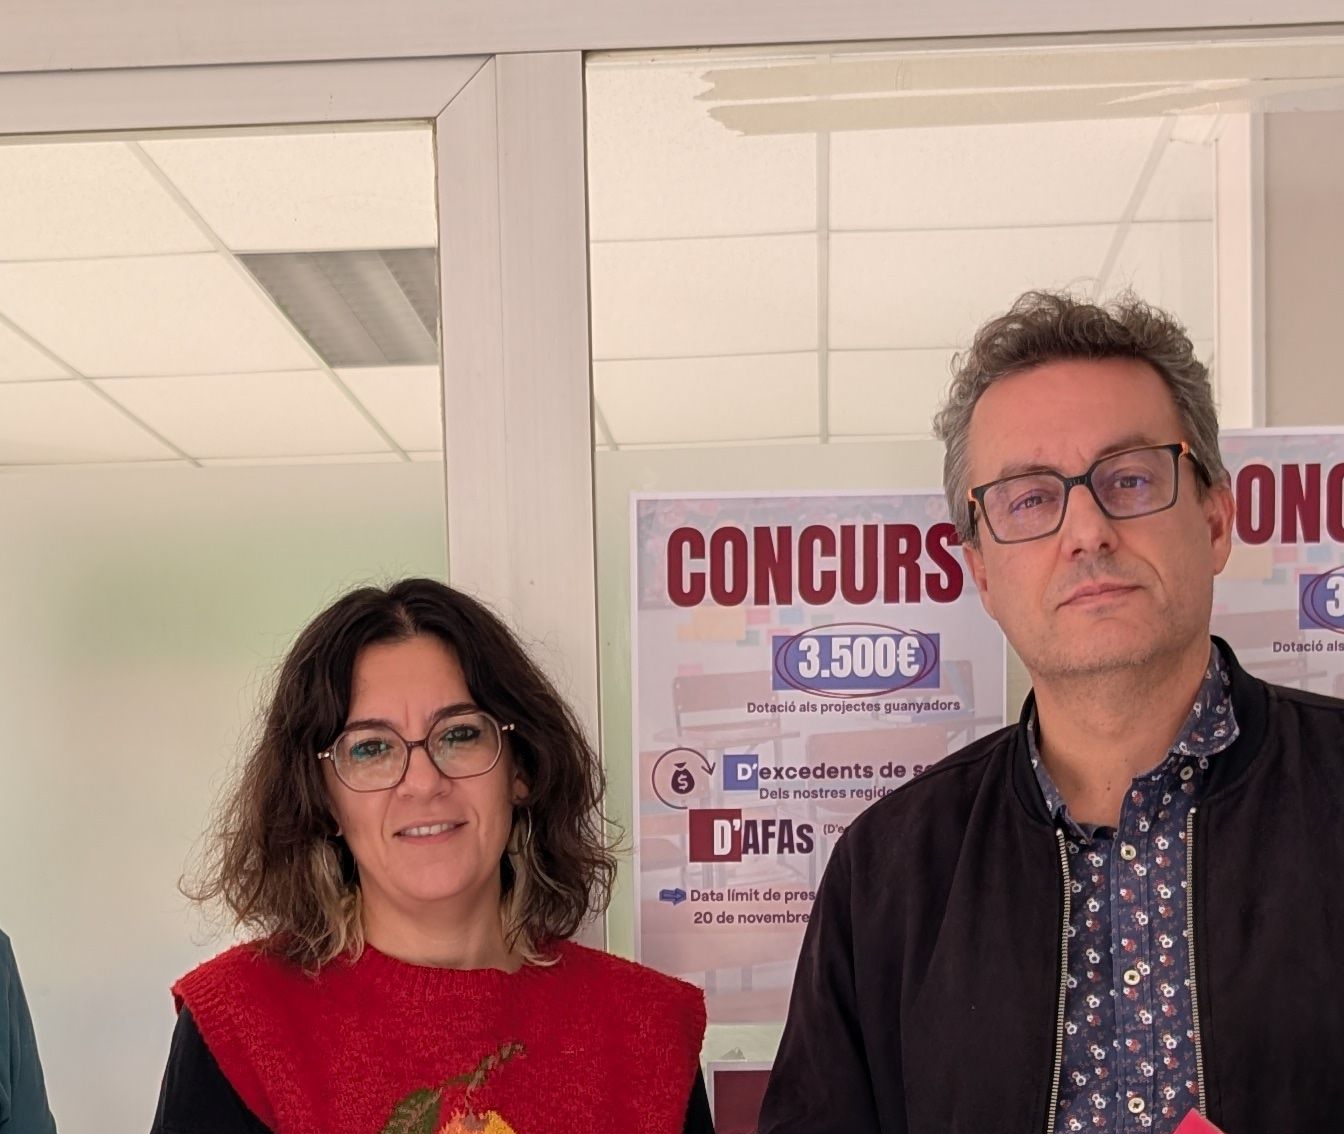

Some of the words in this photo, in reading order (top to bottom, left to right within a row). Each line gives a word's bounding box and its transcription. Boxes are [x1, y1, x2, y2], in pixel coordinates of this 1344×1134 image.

[667, 523, 963, 608] CONCURS
[1272, 640, 1324, 654] Dotació
[1326, 640, 1344, 653] als
[798, 637, 920, 679] 3.500€
[746, 700, 796, 714] Dotació
[799, 701, 817, 713] als
[820, 701, 881, 716] projectes
[884, 700, 961, 716] guanyadors
[736, 762, 873, 782] D'excedents
[880, 762, 907, 779] de
[760, 786, 790, 801] Dels
[792, 787, 847, 800] nostres
[690, 888, 724, 903] Data
[726, 888, 761, 902] límit
[763, 888, 781, 902] de
[784, 890, 816, 904] pres
[694, 912, 713, 925] 20
[716, 911, 734, 924] de
[738, 911, 810, 924] novembre
